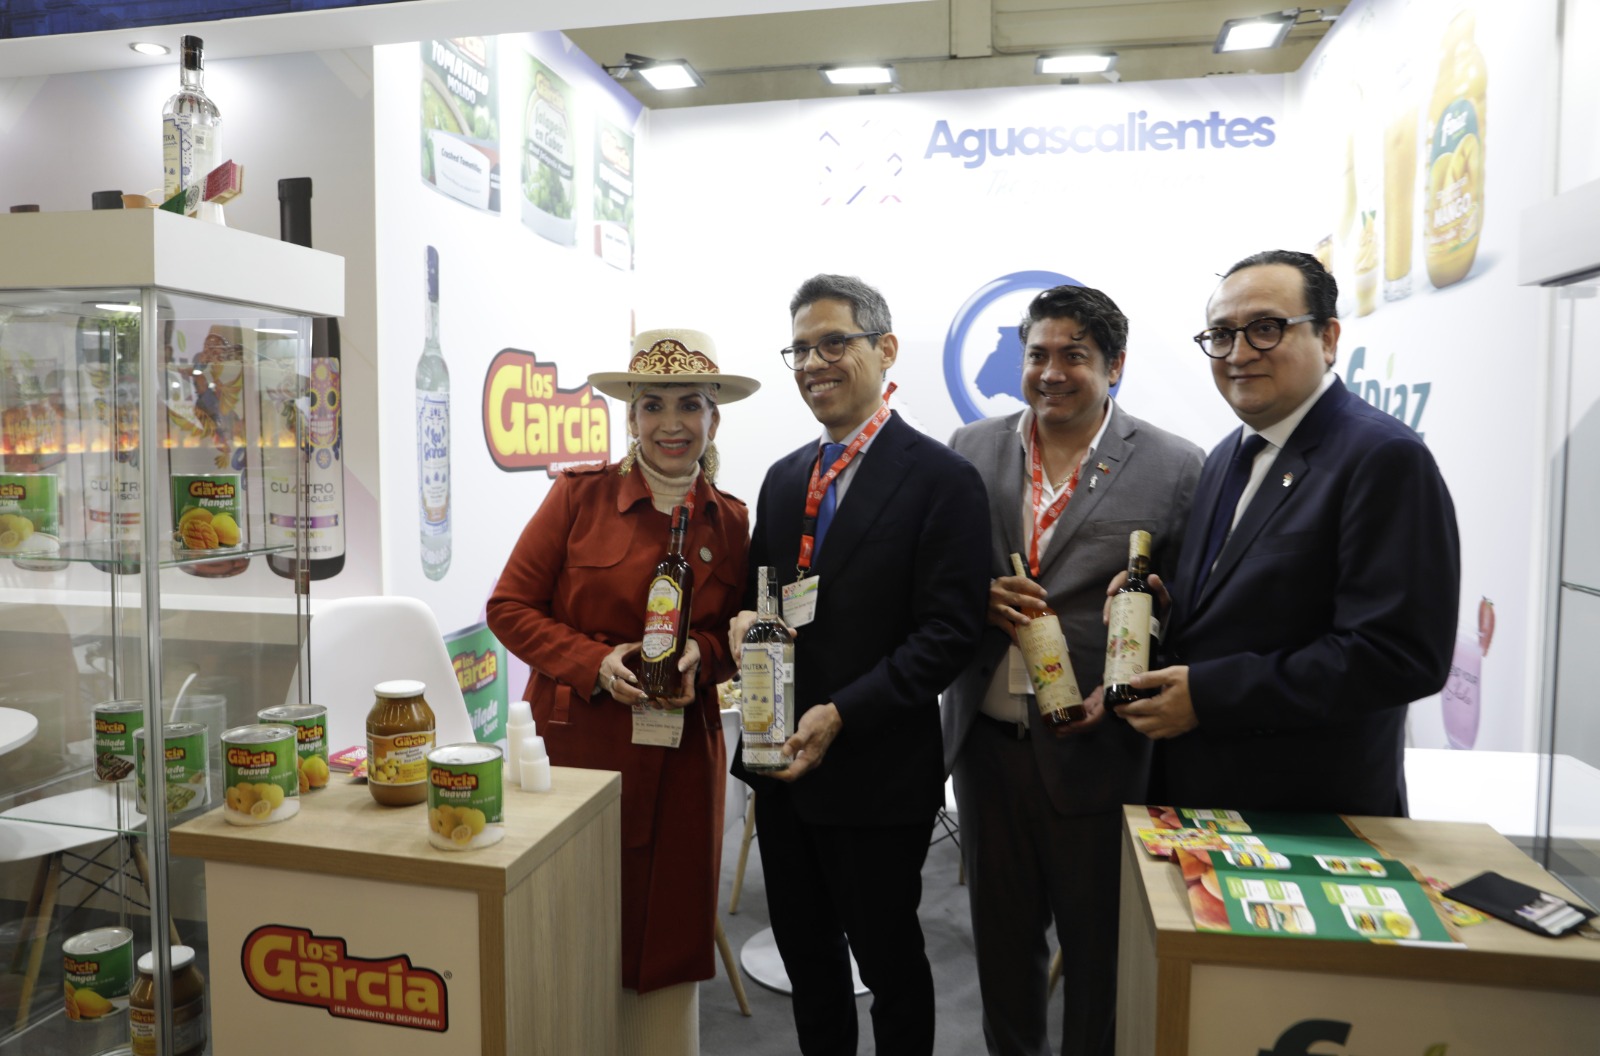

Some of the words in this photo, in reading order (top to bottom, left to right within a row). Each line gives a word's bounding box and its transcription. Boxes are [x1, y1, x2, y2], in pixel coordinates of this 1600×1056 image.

[432, 39, 489, 95] TOMATILLO
[447, 74, 476, 104] MOLIDO
[923, 110, 1276, 169] Aguascalientes
[525, 363, 554, 399] los
[489, 364, 608, 456] García
[189, 482, 235, 497] García
[198, 498, 234, 509] Mangos
[227, 748, 275, 765] García
[237, 766, 271, 776] Guavas
[431, 768, 477, 787] García
[439, 789, 472, 799] Guavas
[297, 935, 339, 963] los
[250, 934, 440, 1015] García
[346, 1006, 385, 1021] MOMENTO
[385, 1012, 396, 1022] DE
[396, 1013, 441, 1028] DISFRUTAR!
